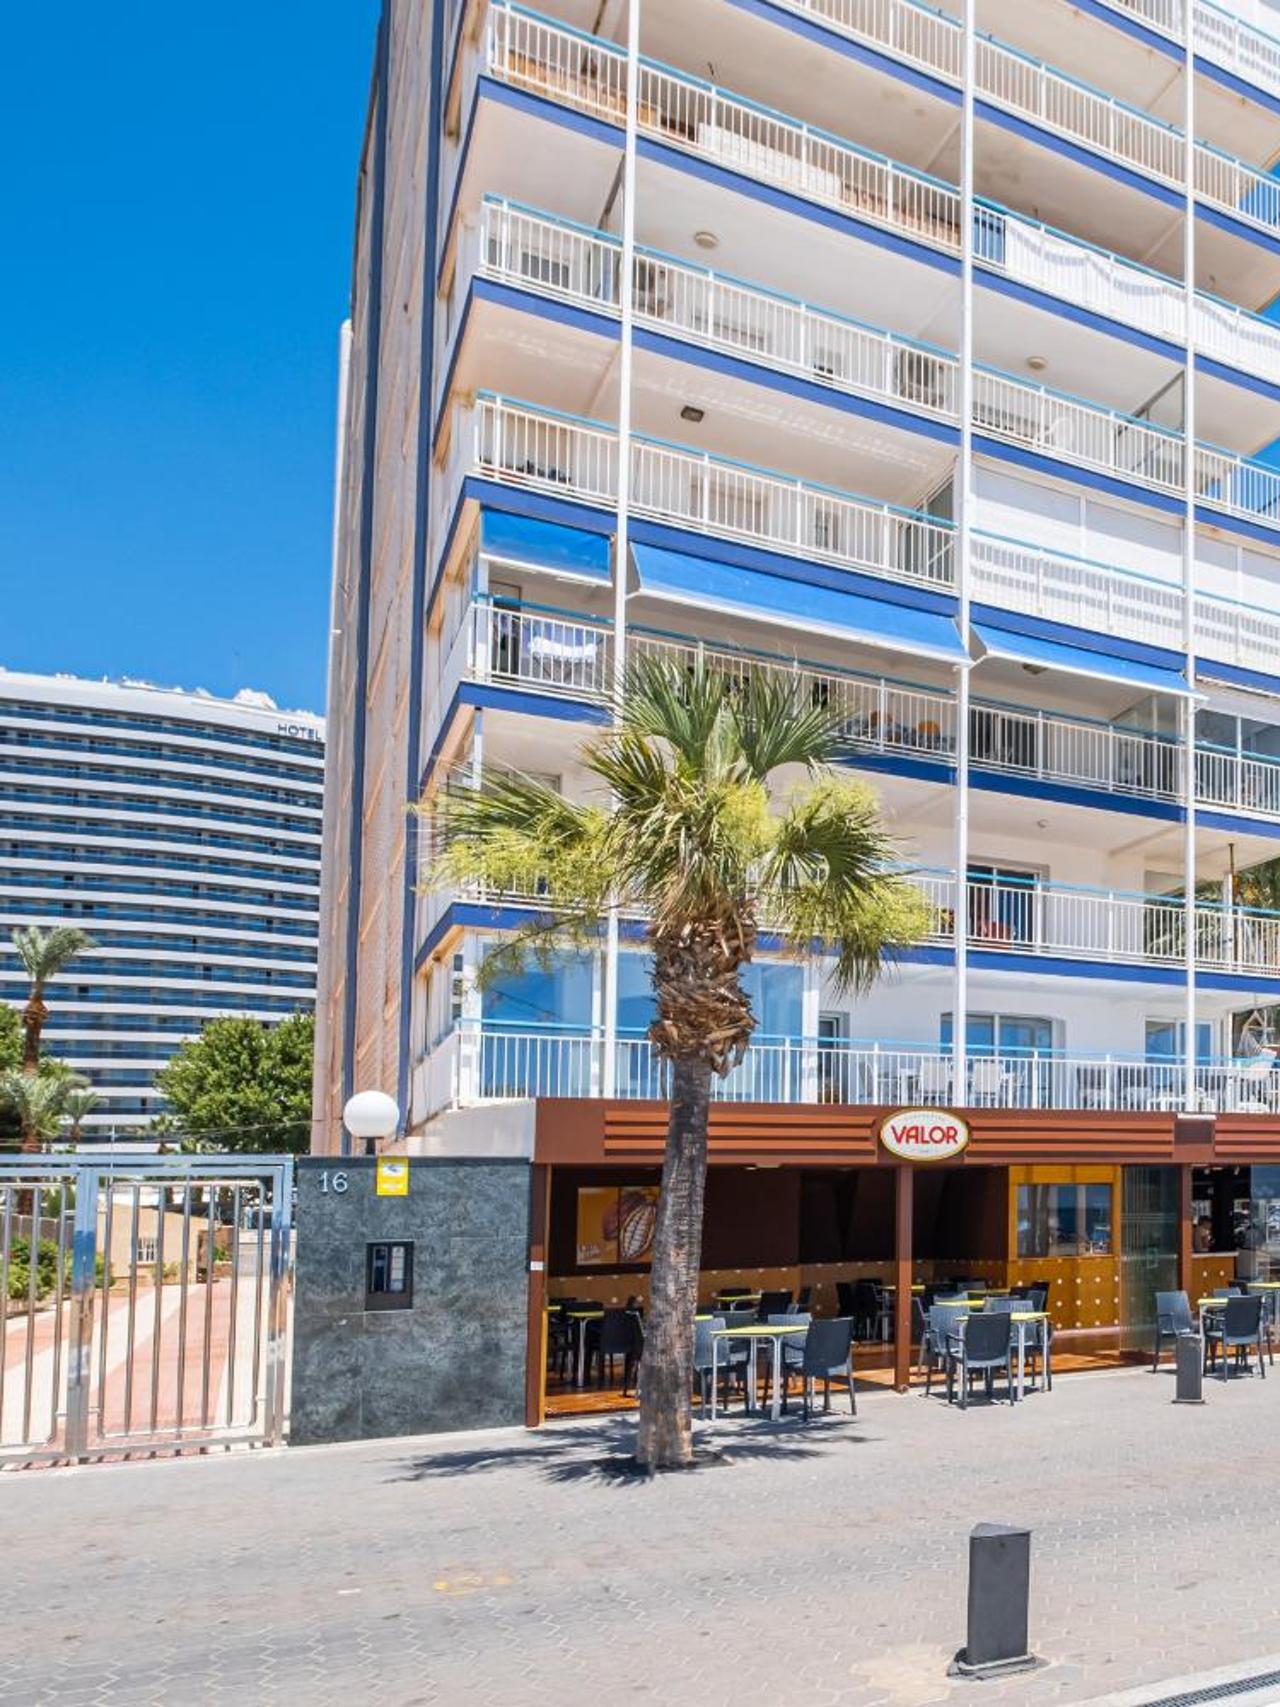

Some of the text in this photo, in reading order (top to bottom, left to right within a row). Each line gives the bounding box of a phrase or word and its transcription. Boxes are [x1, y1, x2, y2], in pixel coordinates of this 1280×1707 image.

[277, 723, 321, 741] HOTEL
[891, 1125, 958, 1144] VALOR
[319, 1171, 349, 1193] 16
